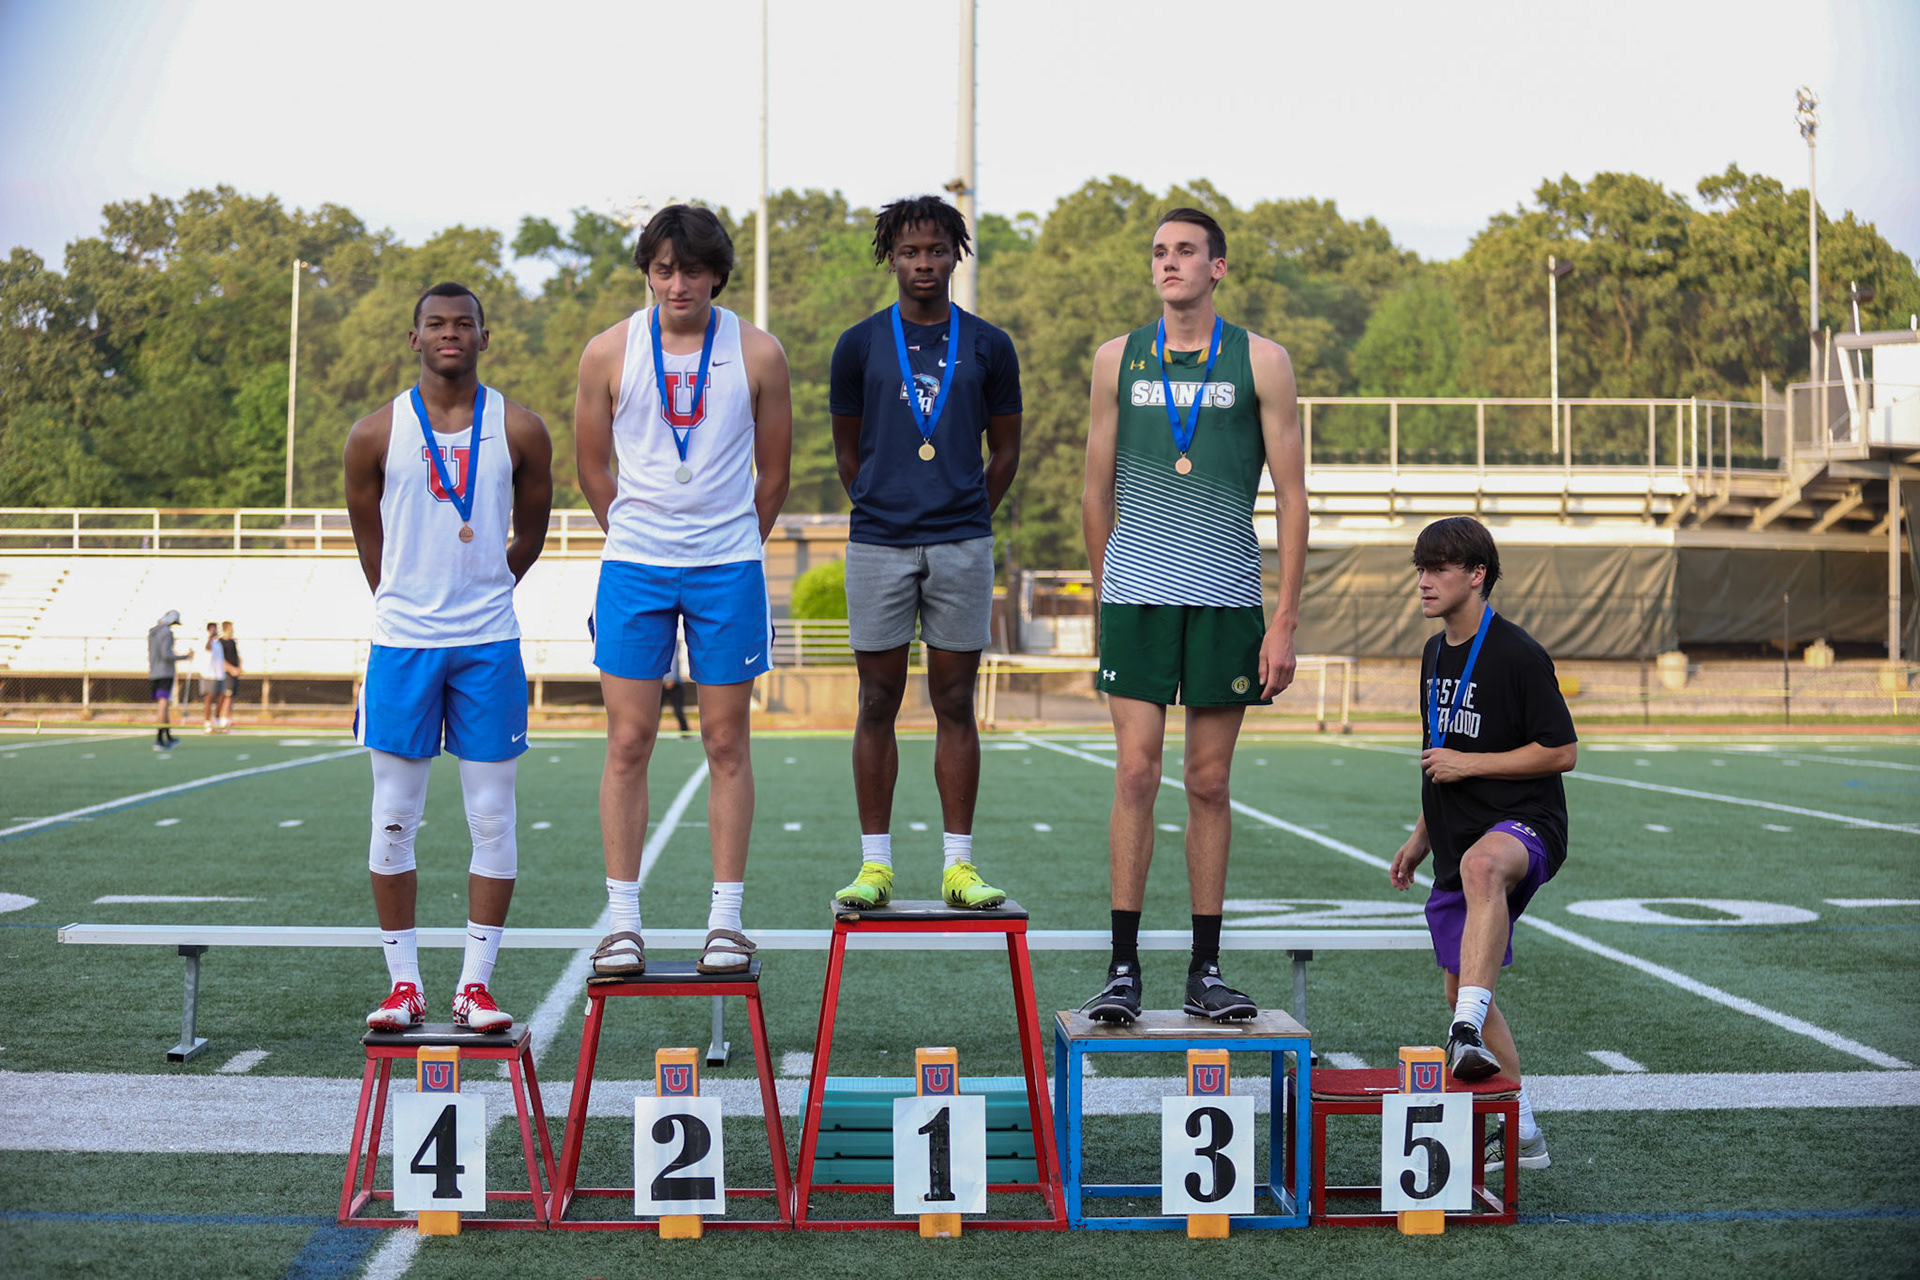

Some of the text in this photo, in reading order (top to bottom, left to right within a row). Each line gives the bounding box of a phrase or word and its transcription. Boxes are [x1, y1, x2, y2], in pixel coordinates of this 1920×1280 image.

[657, 371, 711, 430] U
[1131, 379, 1236, 409] SAINTS
[425, 1064, 451, 1089] U
[664, 1067, 689, 1092] U
[926, 1067, 951, 1092] U
[1196, 1068, 1221, 1092] U
[1414, 1065, 1439, 1090] U
[410, 1104, 465, 1199] 4
[650, 1113, 716, 1201] 2
[918, 1106, 956, 1202] 1
[1184, 1106, 1236, 1203] 3
[1400, 1103, 1451, 1200] 5
